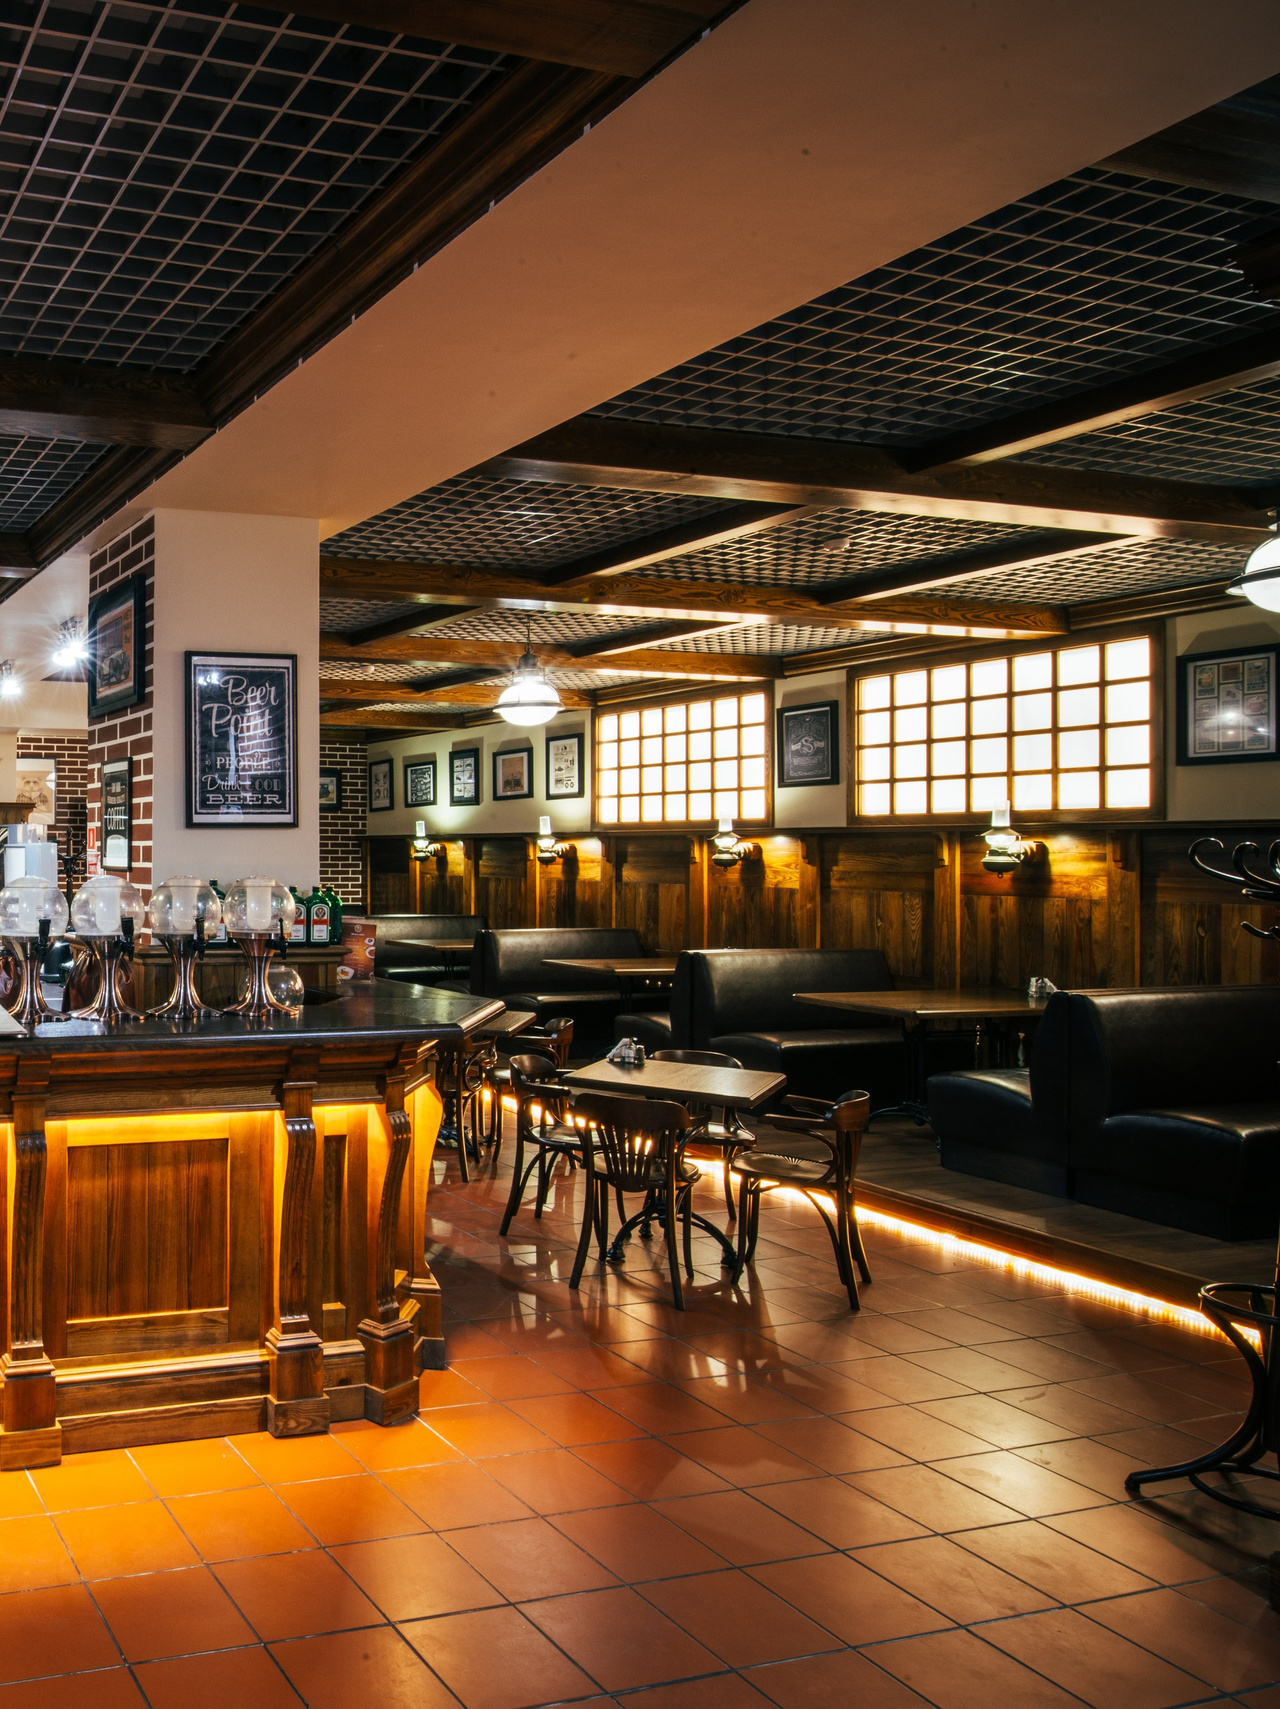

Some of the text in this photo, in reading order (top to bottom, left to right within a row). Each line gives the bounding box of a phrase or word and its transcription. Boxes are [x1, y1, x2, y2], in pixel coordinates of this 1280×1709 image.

[219, 675, 280, 706] Beer
[202, 703, 273, 738] Point
[216, 756, 271, 769] PEOPLE
[201, 773, 282, 791] Drink GOOD
[206, 794, 283, 805] BEER
[106, 806, 125, 830] COFFEE
